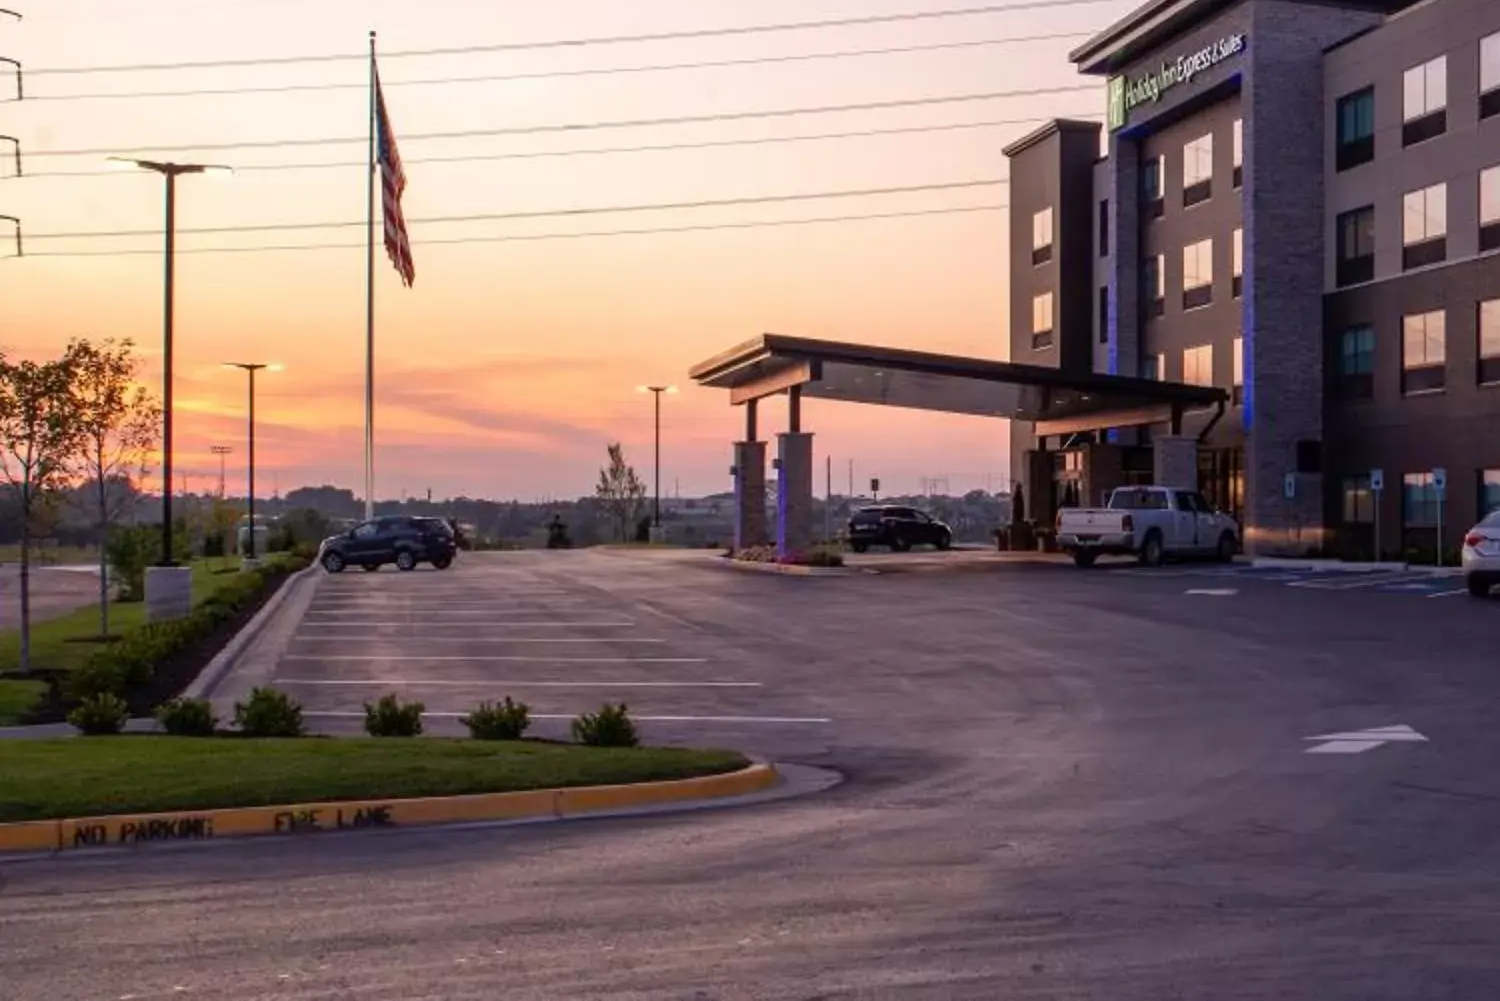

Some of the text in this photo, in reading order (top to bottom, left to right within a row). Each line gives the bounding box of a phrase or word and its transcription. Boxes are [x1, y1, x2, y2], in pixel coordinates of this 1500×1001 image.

[1177, 46, 1211, 83] Express
[74, 813, 214, 847] NO PARKING
